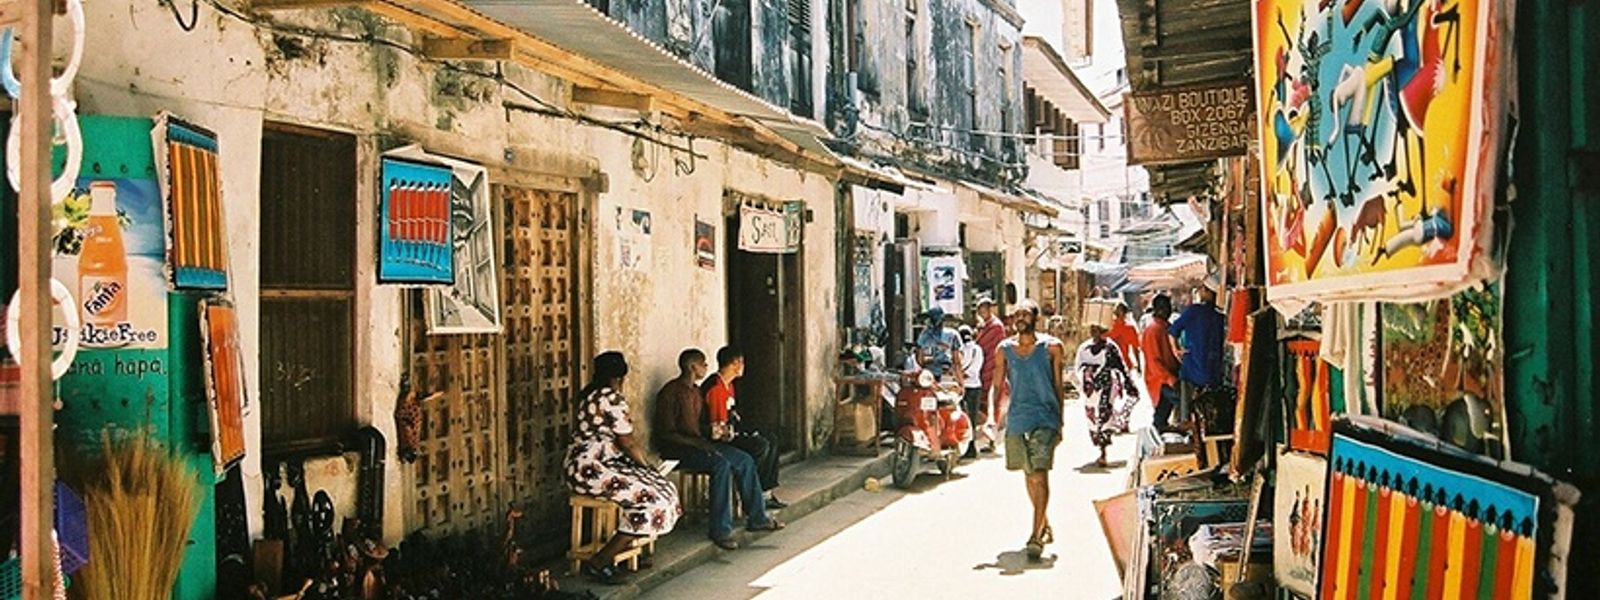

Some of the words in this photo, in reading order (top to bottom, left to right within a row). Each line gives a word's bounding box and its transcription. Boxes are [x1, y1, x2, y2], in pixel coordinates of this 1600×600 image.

[1178, 87, 1249, 108] BOUTIQUE
[1171, 109, 1201, 125] BOX
[1205, 104, 1246, 122] 2067
[1176, 137, 1248, 153] ZANZIBAR
[84, 281, 121, 316] Fanta
